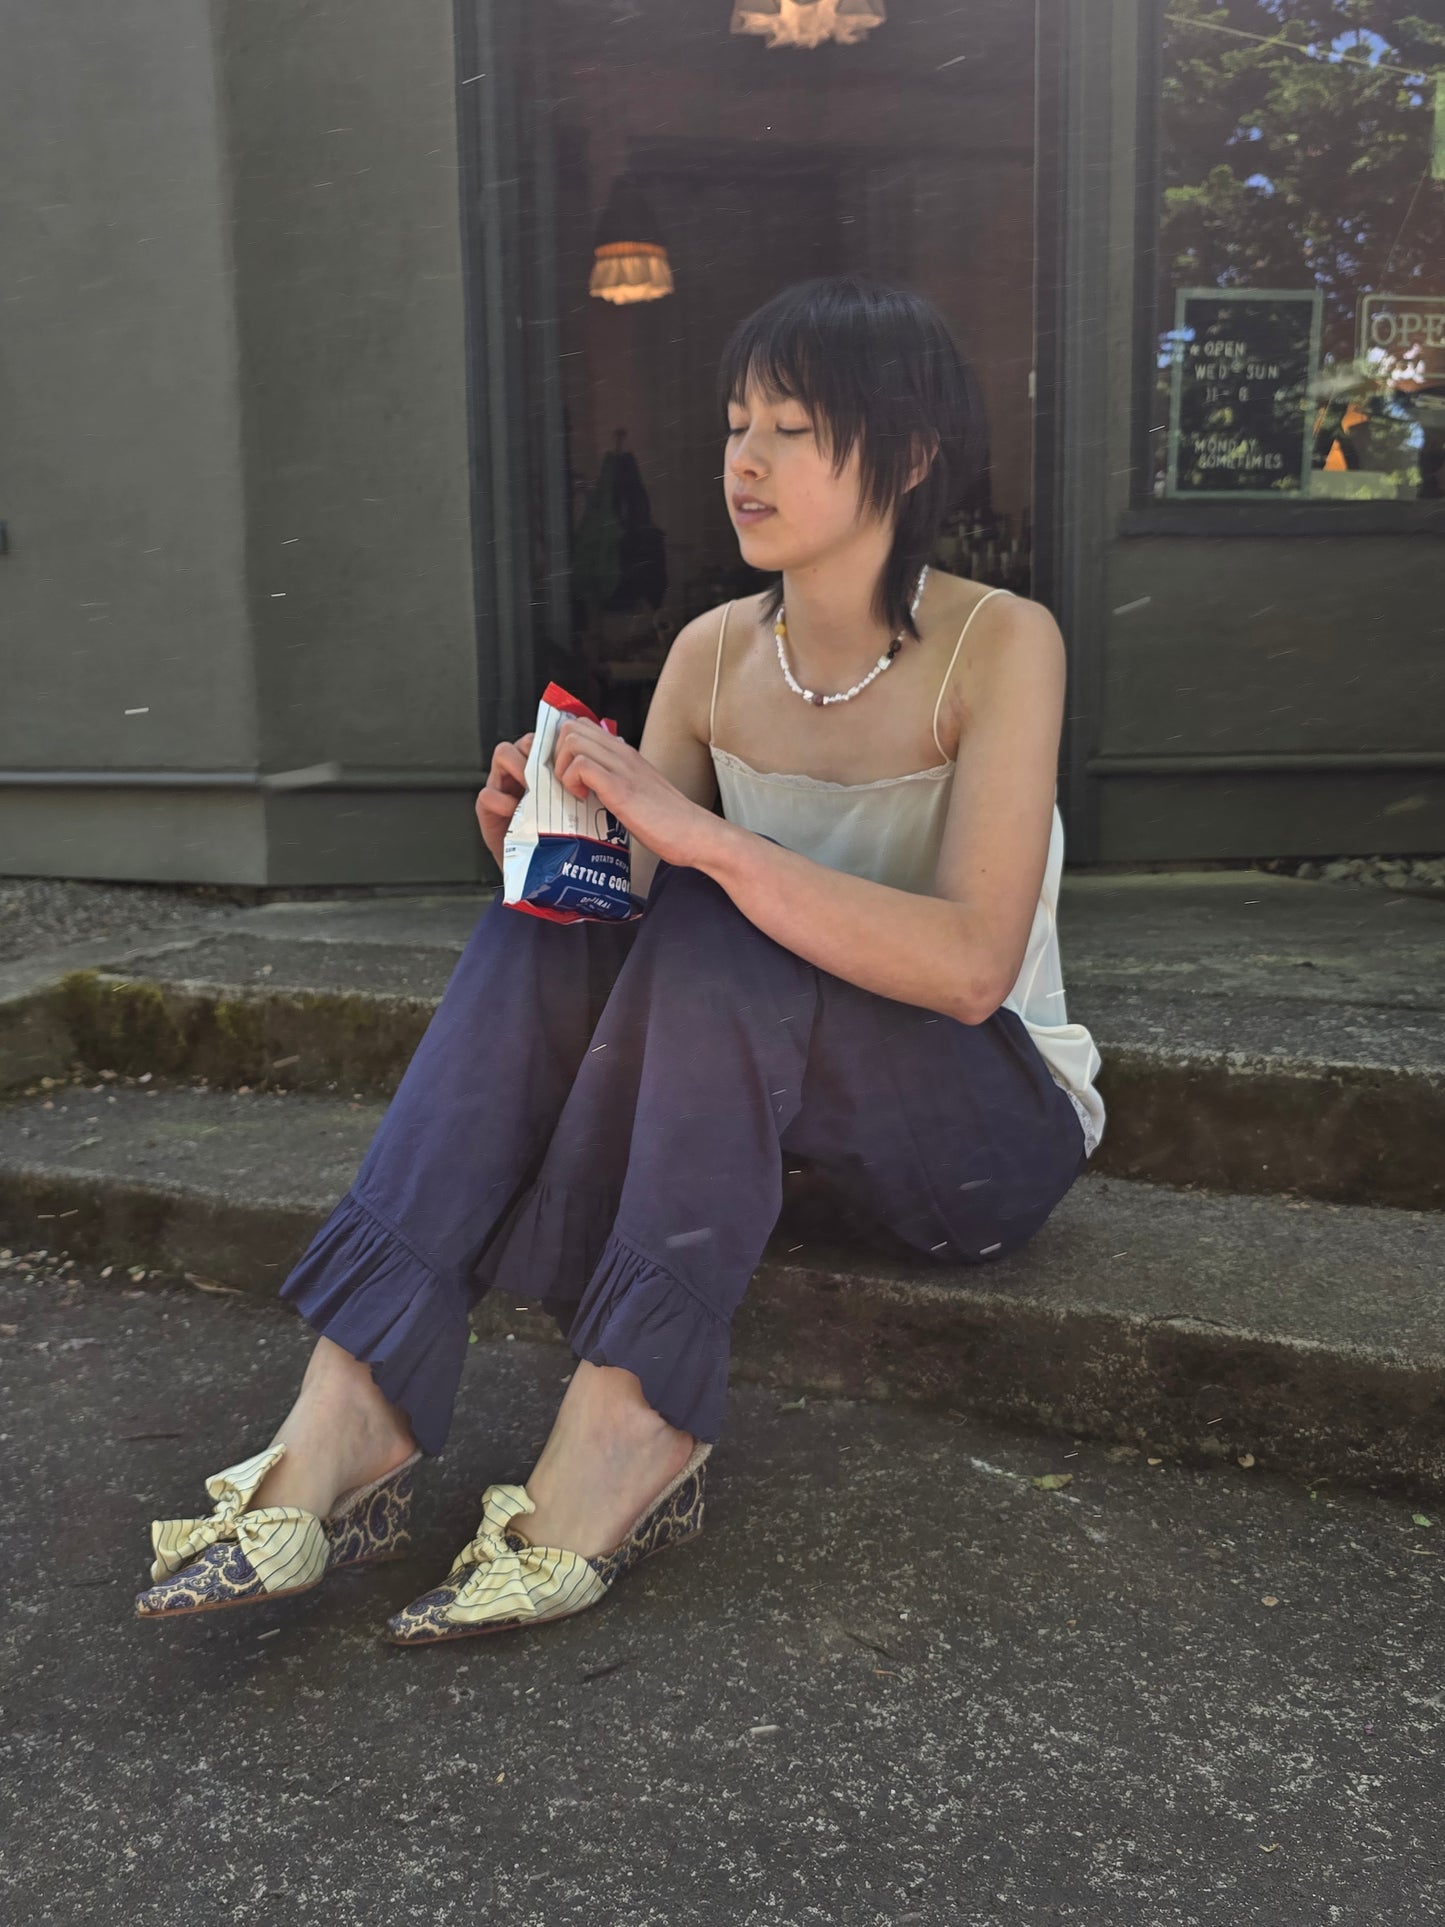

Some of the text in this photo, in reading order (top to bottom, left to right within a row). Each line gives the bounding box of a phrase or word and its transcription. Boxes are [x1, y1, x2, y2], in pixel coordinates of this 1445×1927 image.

[1204, 340, 1246, 358] OPEN
[1195, 363, 1227, 381] WED
[1246, 363, 1279, 381] SUN
[1194, 438, 1257, 454] MONDAY
[1199, 453, 1283, 470] SOMETIMES
[591, 854, 614, 864] POTATO
[562, 862, 606, 887] KETTLE
